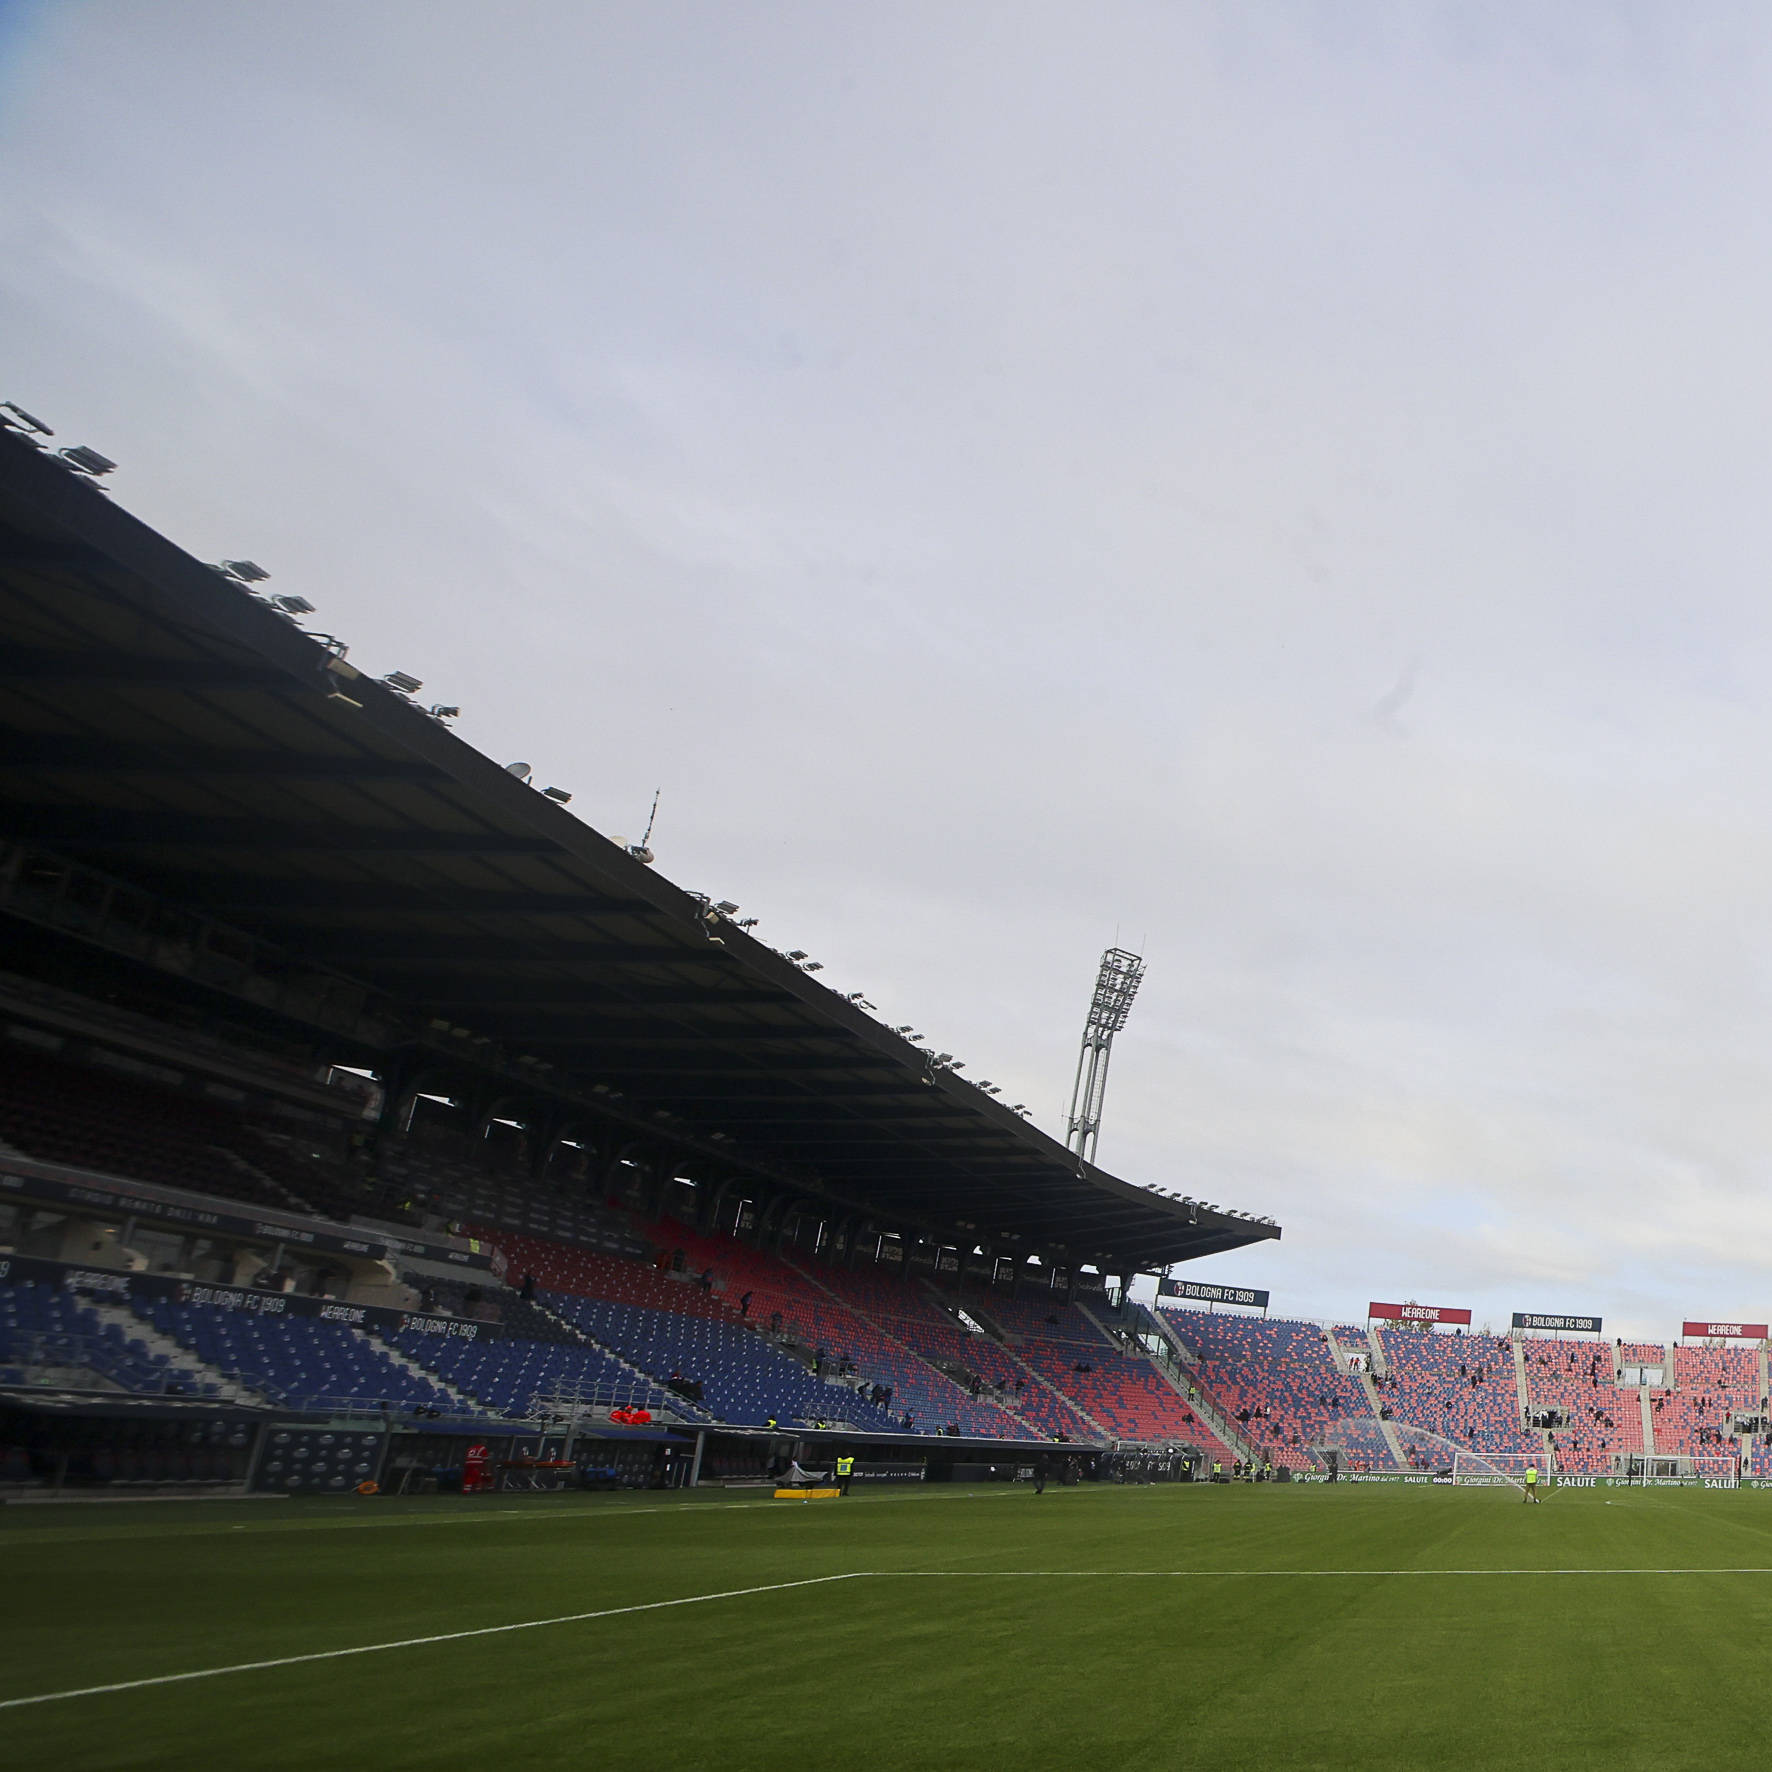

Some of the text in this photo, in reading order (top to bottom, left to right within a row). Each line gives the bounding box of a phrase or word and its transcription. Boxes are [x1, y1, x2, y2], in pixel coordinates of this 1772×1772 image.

[191, 1287, 287, 1312] BOLOGNA FC 1909
[1186, 1284, 1255, 1303] BOLOGNA FC 1909
[1402, 1307, 1440, 1319] WEAREONE
[410, 1317, 478, 1337] BOLOGNA FC 1909
[1532, 1316, 1592, 1329] BOLOGNA FC 1909
[1708, 1324, 1743, 1335] WEAREONE
[1337, 1473, 1347, 1482] Dr.
[1349, 1473, 1381, 1482] Martino
[1557, 1477, 1596, 1487] SALUTE
[1654, 1478, 1681, 1486] Martino
